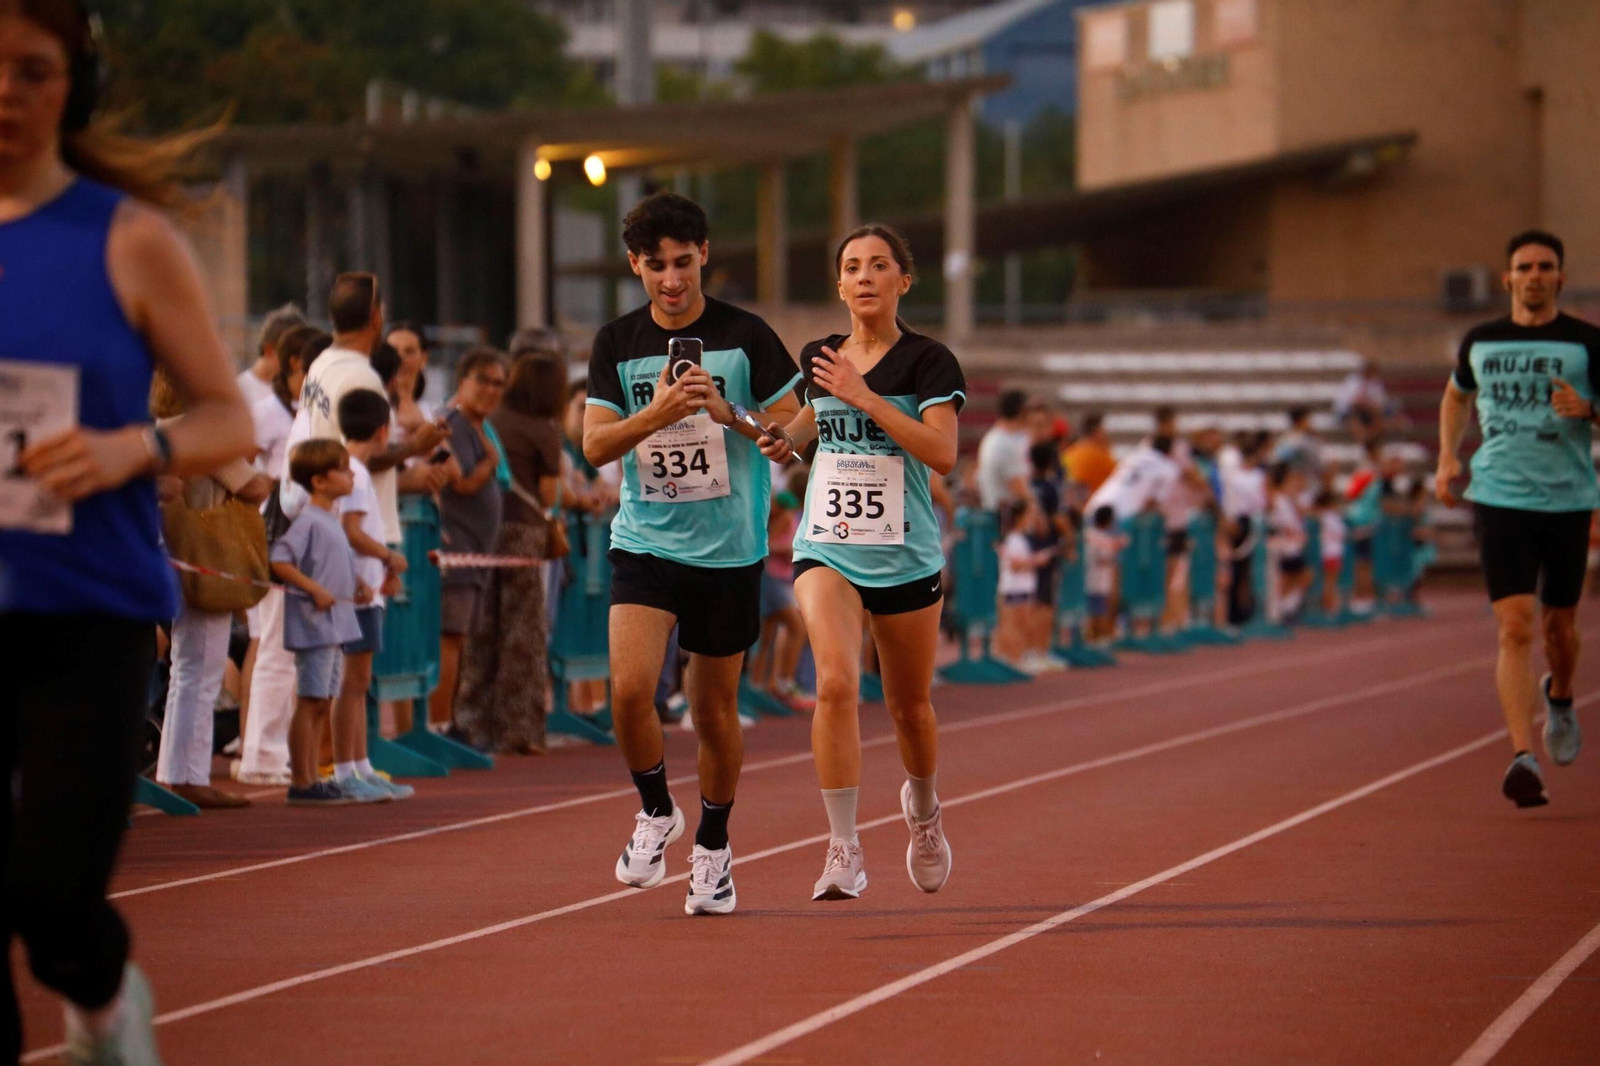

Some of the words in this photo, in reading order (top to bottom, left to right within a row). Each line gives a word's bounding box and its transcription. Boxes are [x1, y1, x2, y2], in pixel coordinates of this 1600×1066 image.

[1482, 357, 1564, 375] MUJER
[650, 448, 710, 479] 334
[826, 488, 885, 519] 335
